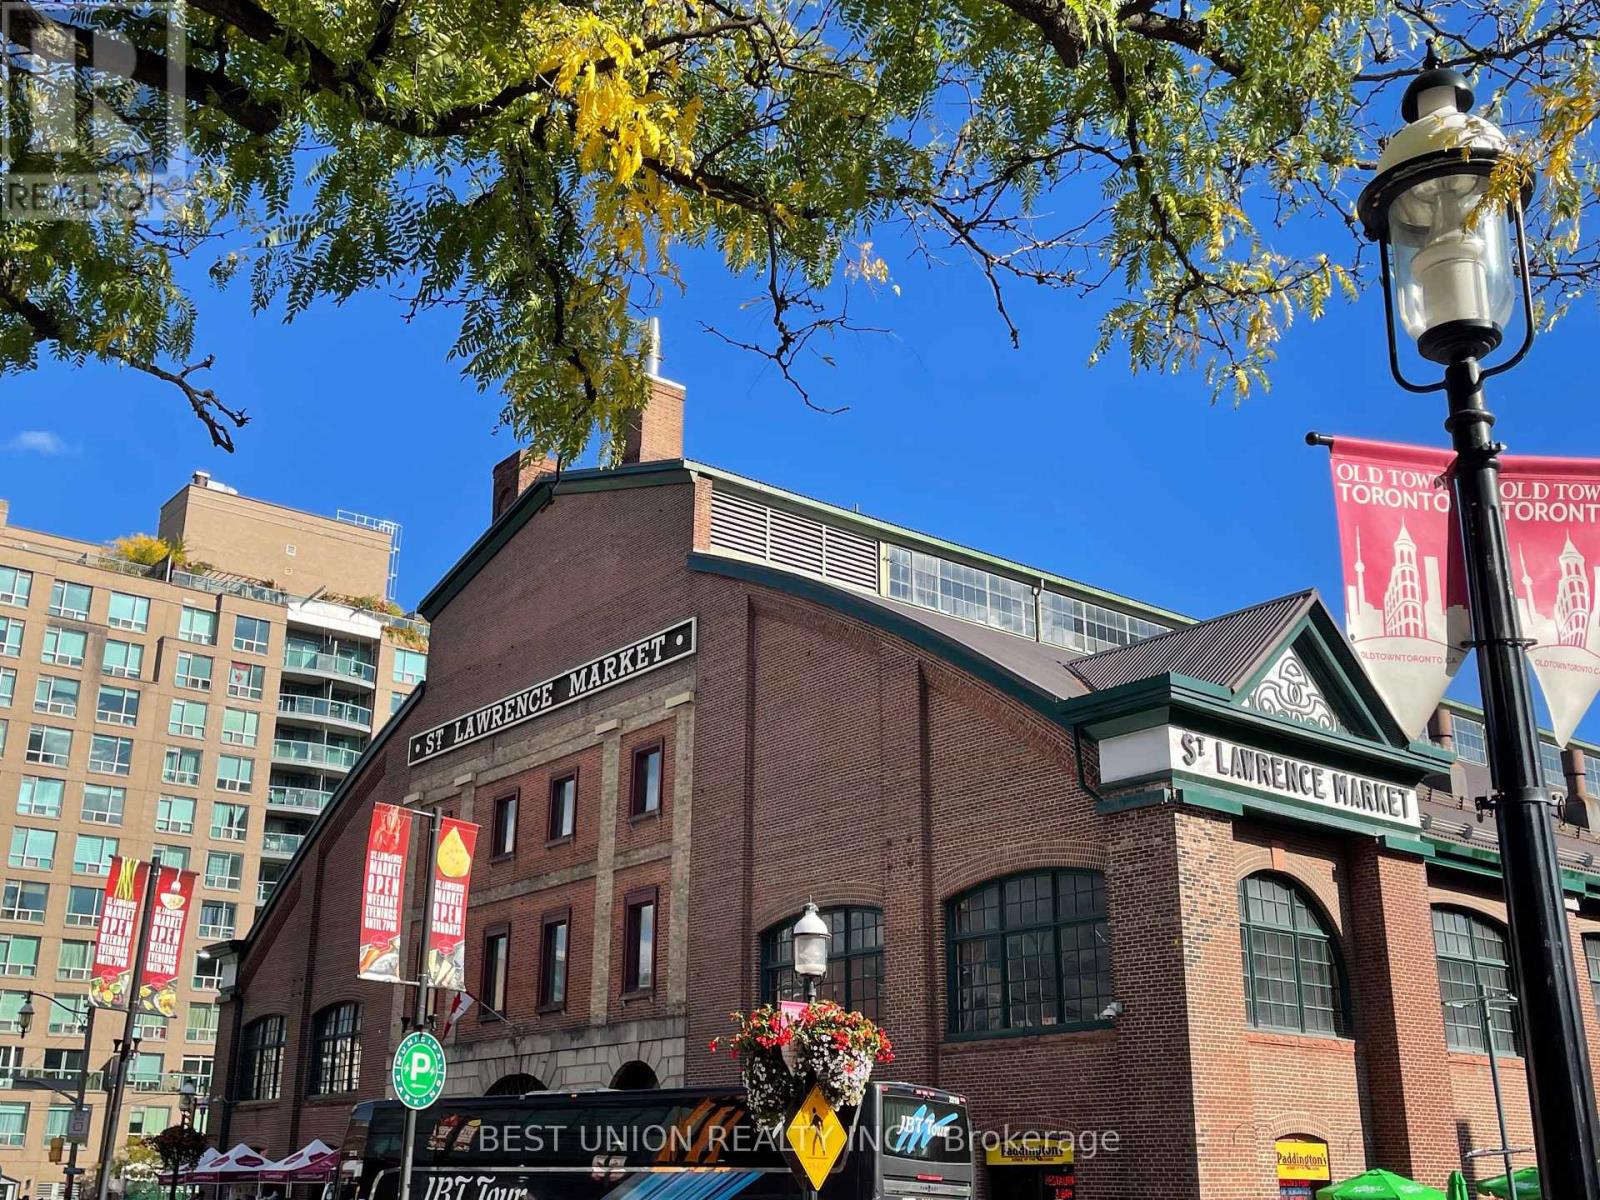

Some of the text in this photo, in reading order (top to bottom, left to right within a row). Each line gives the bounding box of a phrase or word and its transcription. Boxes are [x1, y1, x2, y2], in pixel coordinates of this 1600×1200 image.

[1336, 463, 1384, 489] OLD
[1338, 483, 1450, 513] TORONTO
[1500, 481, 1549, 499] OLD
[454, 683, 553, 744] LAWRENCE
[568, 635, 666, 697] MARKET
[1215, 741, 1328, 800] LAWRENCE
[1333, 772, 1411, 820] MARKET
[370, 860, 402, 878] MARKET
[368, 874, 400, 896] OPEN
[367, 893, 398, 908] WEEKDAY
[435, 889, 464, 906] MARKET
[105, 905, 136, 921] MARKET
[154, 914, 183, 929] MARKET
[434, 903, 462, 924] OPEN
[103, 917, 134, 936] OPEN
[152, 926, 181, 946] OPEN
[433, 921, 461, 936] SUNDAYS
[101, 933, 130, 946] WEEKDAY
[150, 942, 178, 954] WEEKDAY
[410, 1052, 431, 1081] P
[396, 1074, 442, 1106] PARKING
[896, 1114, 924, 1136] JBT
[1276, 1151, 1327, 1166] Paddington's
